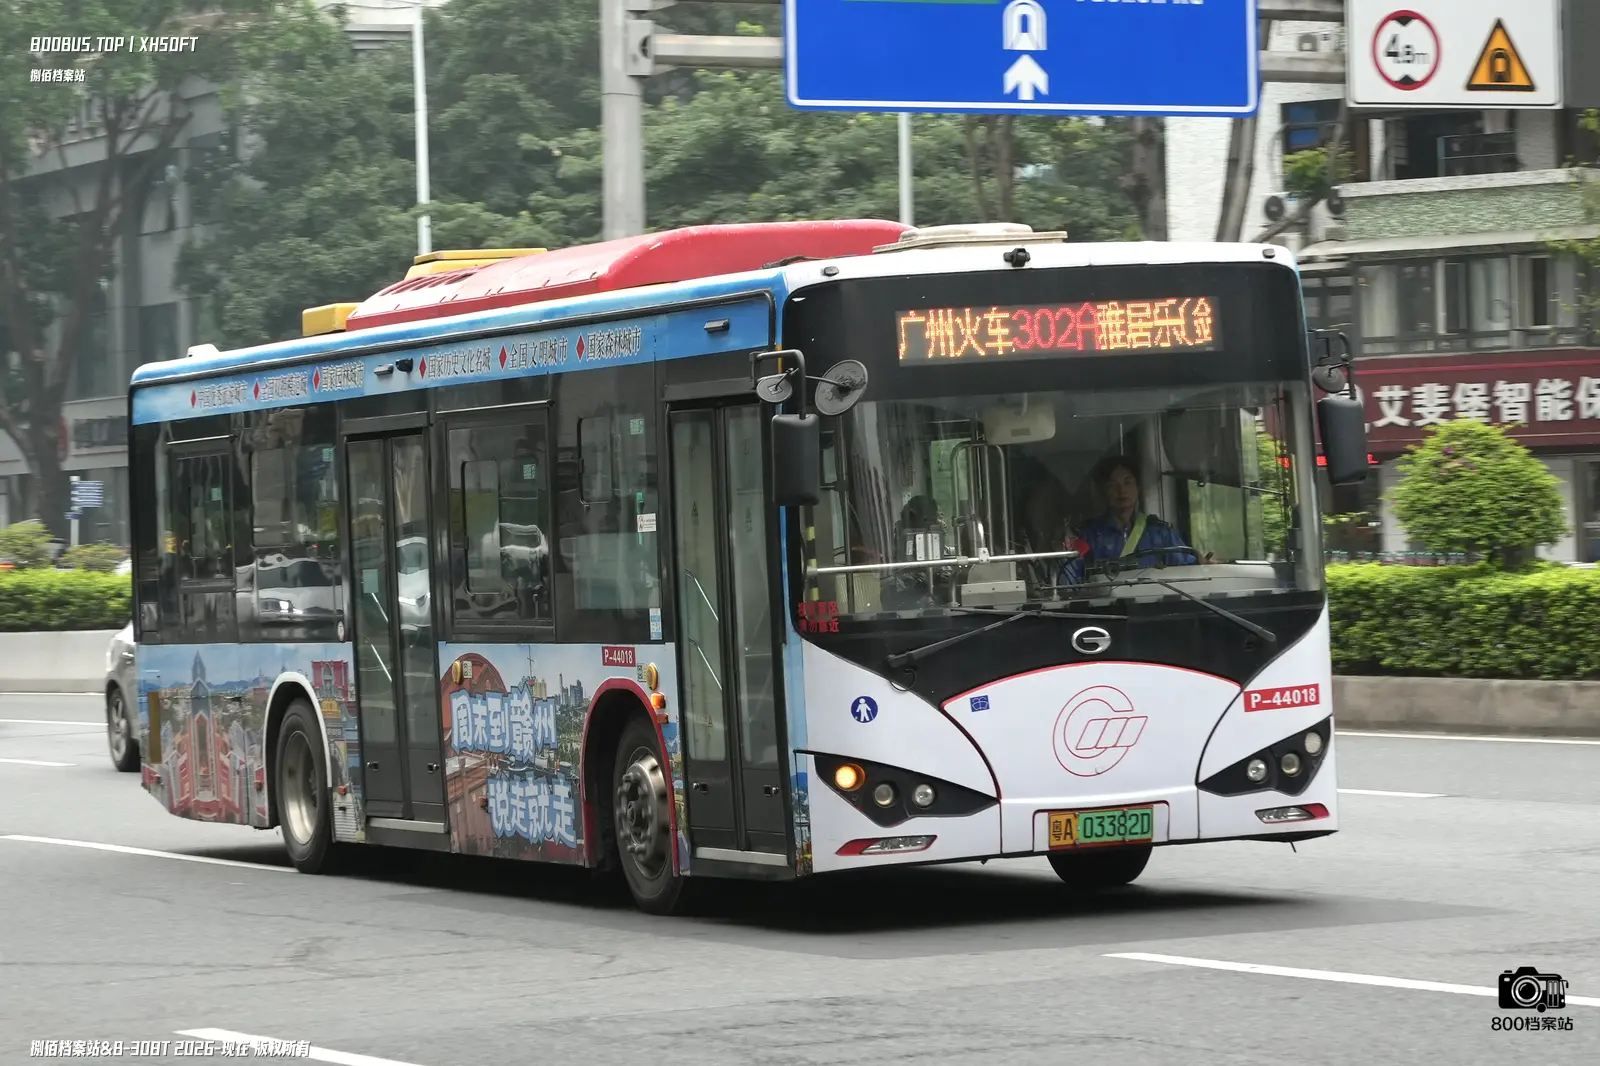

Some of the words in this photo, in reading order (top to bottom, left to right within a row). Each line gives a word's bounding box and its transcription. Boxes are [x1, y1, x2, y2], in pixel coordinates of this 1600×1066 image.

[508, 336, 569, 370] 全国文明城市
[586, 325, 642, 361] 国家森林城市
[427, 345, 492, 379] 国家历史文化名城
[604, 649, 633, 664] P-44018
[1250, 687, 1317, 708] P-44018
[452, 687, 556, 760] 周末到赣州
[489, 774, 576, 845] 说走就走
[1083, 812, 1150, 839] 03382D
